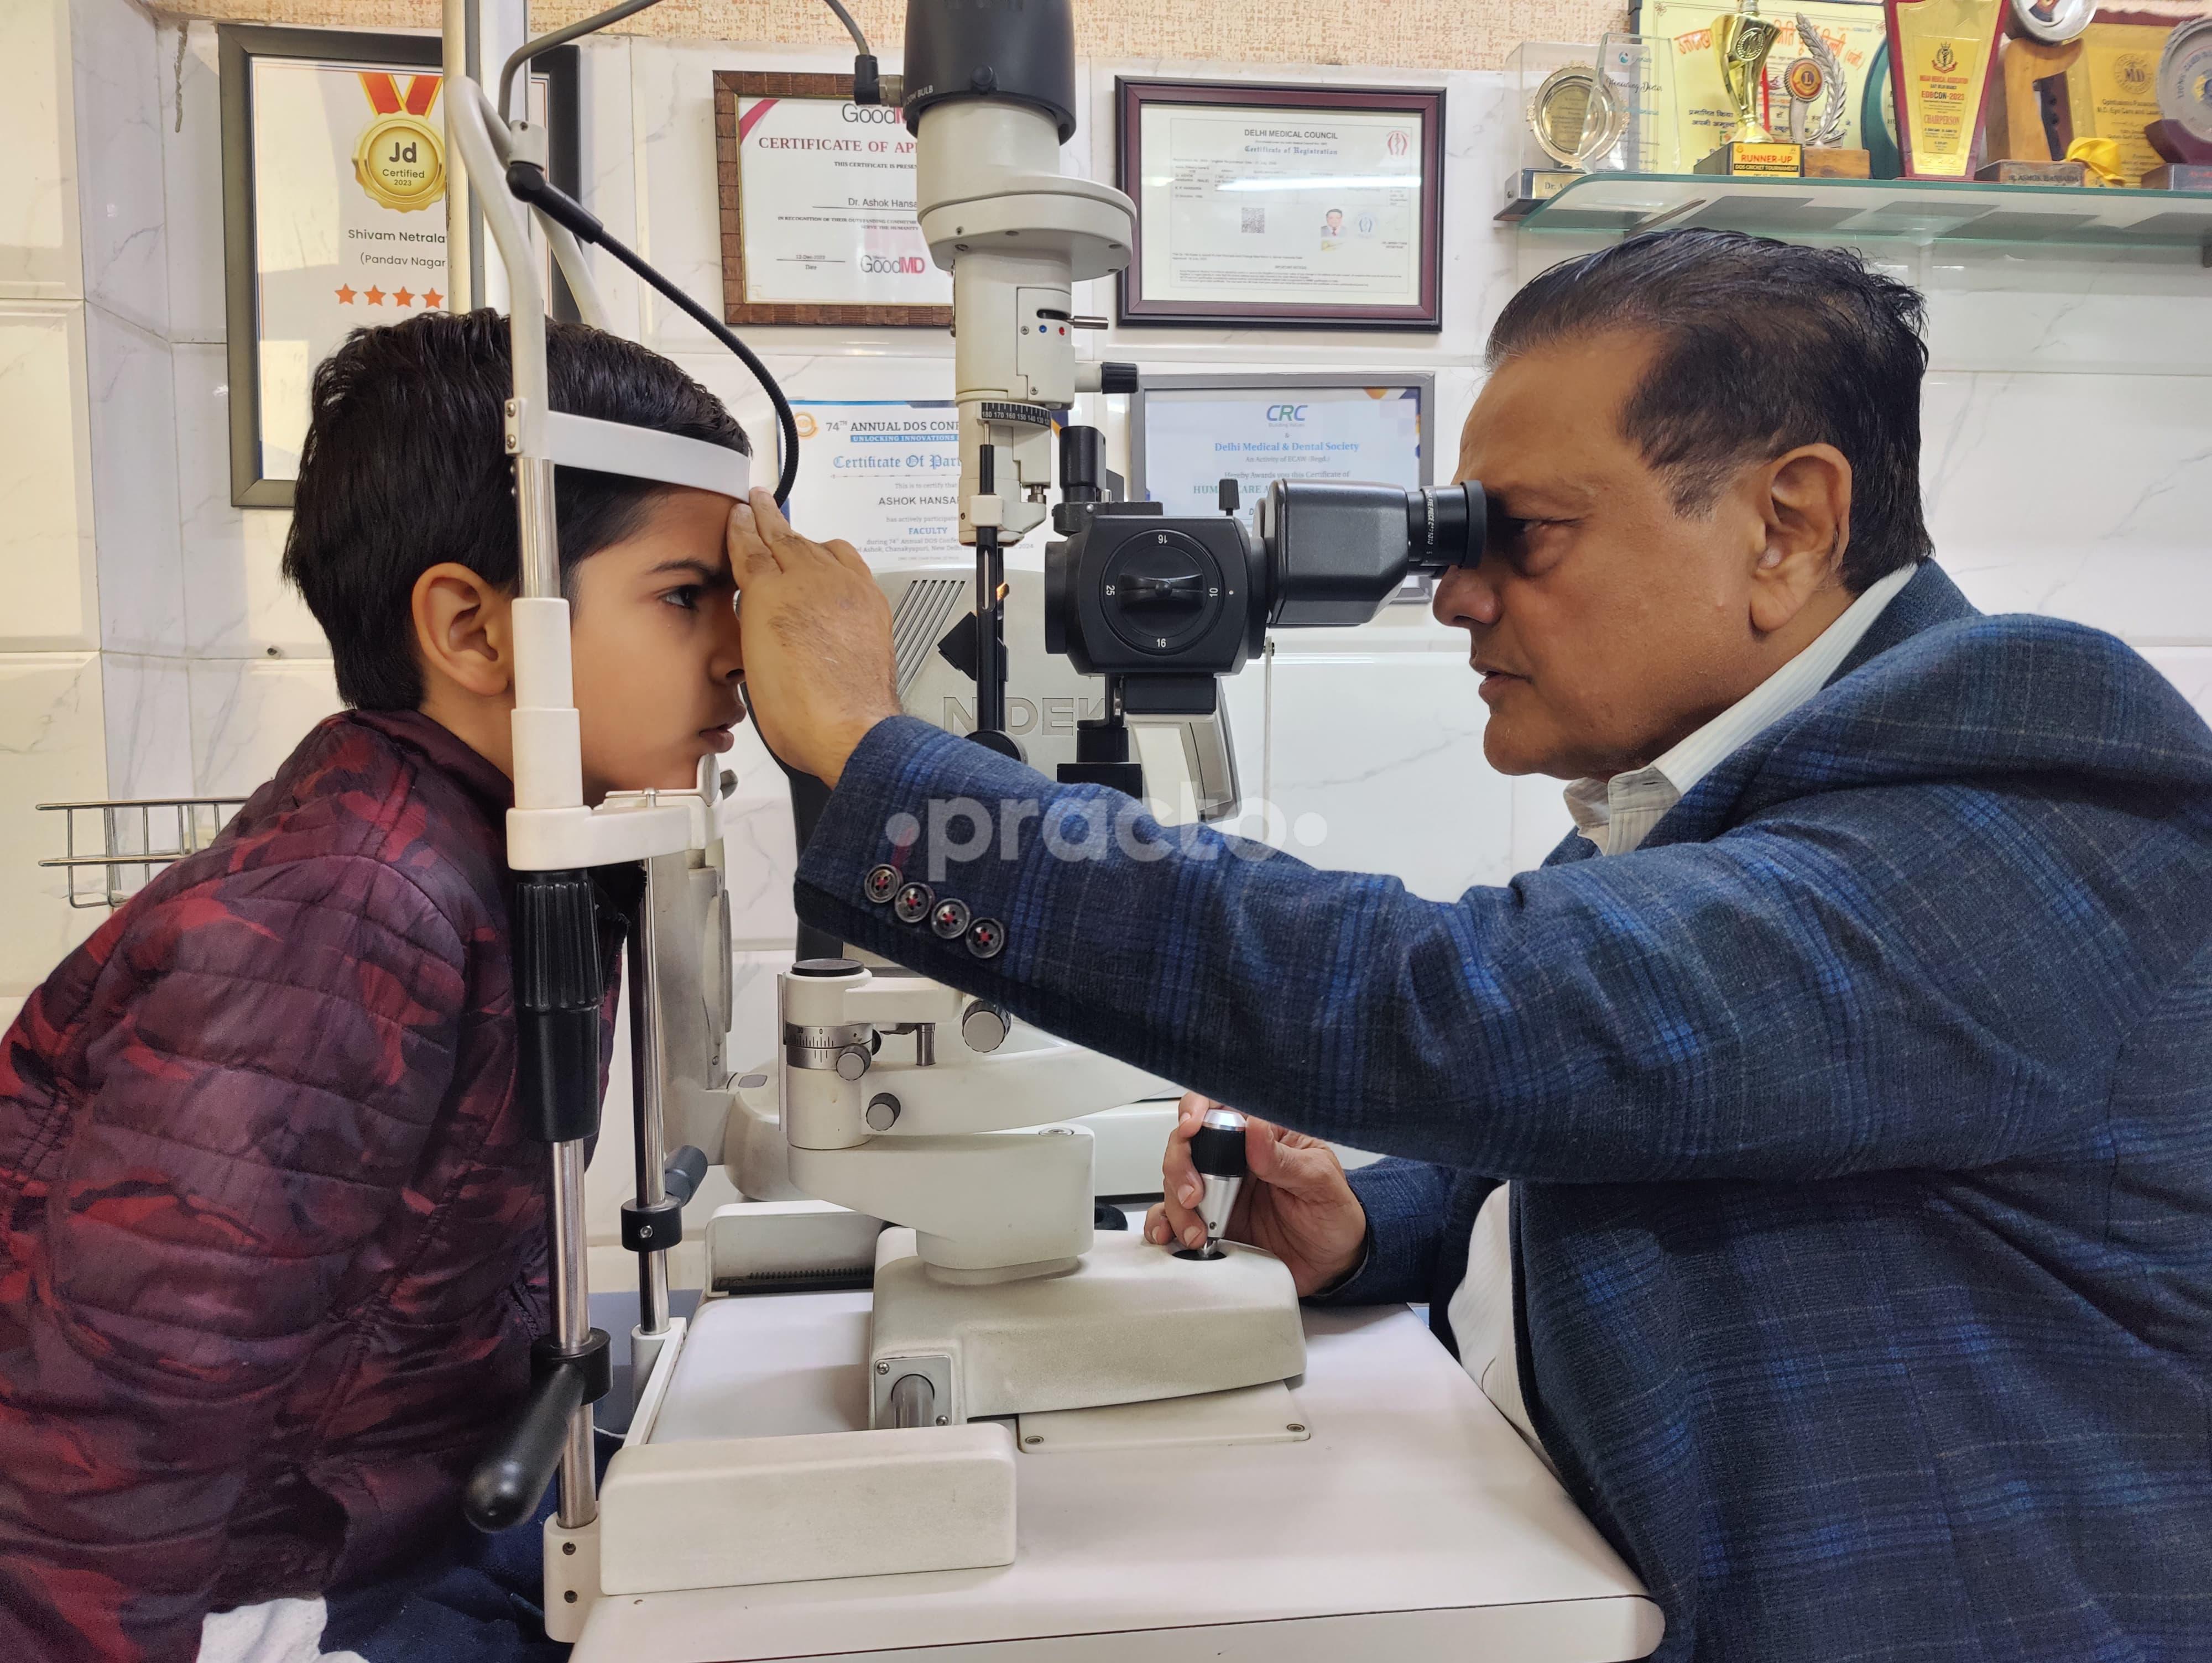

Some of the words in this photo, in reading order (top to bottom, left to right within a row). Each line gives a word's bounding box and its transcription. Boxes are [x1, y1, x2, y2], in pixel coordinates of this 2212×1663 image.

[917, 85, 933, 98] BULB
[1269, 130, 1302, 138] MEDICAL
[1304, 131, 1338, 139] COUNCIL
[759, 137, 862, 151] CERTIFICATE
[868, 141, 889, 153] OF
[389, 142, 416, 163] Jd
[1292, 147, 1338, 155] Registration
[1741, 154, 1793, 164] RUNNER-UP
[382, 169, 425, 178] Certified
[848, 198, 860, 206] Dr.
[863, 198, 889, 207] Ashok
[348, 229, 395, 241] Shivam
[399, 232, 447, 243] Netrala
[360, 252, 408, 265] (Pandav
[860, 254, 925, 274] GoodMD
[1266, 405, 1308, 421] CRC
[850, 422, 901, 431] ANNUAL
[903, 421, 926, 431] DOS
[1215, 443, 1240, 452] Delhi
[1243, 443, 1279, 451] Medical
[1282, 443, 1290, 451] &
[1292, 442, 1323, 451] Dental
[1326, 442, 1360, 452] Society
[833, 456, 901, 469] Certificate
[906, 454, 925, 468] Of
[1225, 472, 1249, 480] Hereby
[1193, 485, 1218, 494] HUM
[1239, 485, 1261, 494] ARE
[878, 497, 917, 505] ASHOK
[908, 527, 948, 535] FACULTY
[1158, 535, 1167, 544] 16
[1106, 585, 1115, 596] 25
[1209, 588, 1218, 597] 10
[1157, 638, 1166, 647] 16
[943, 697, 1105, 738] NDE
